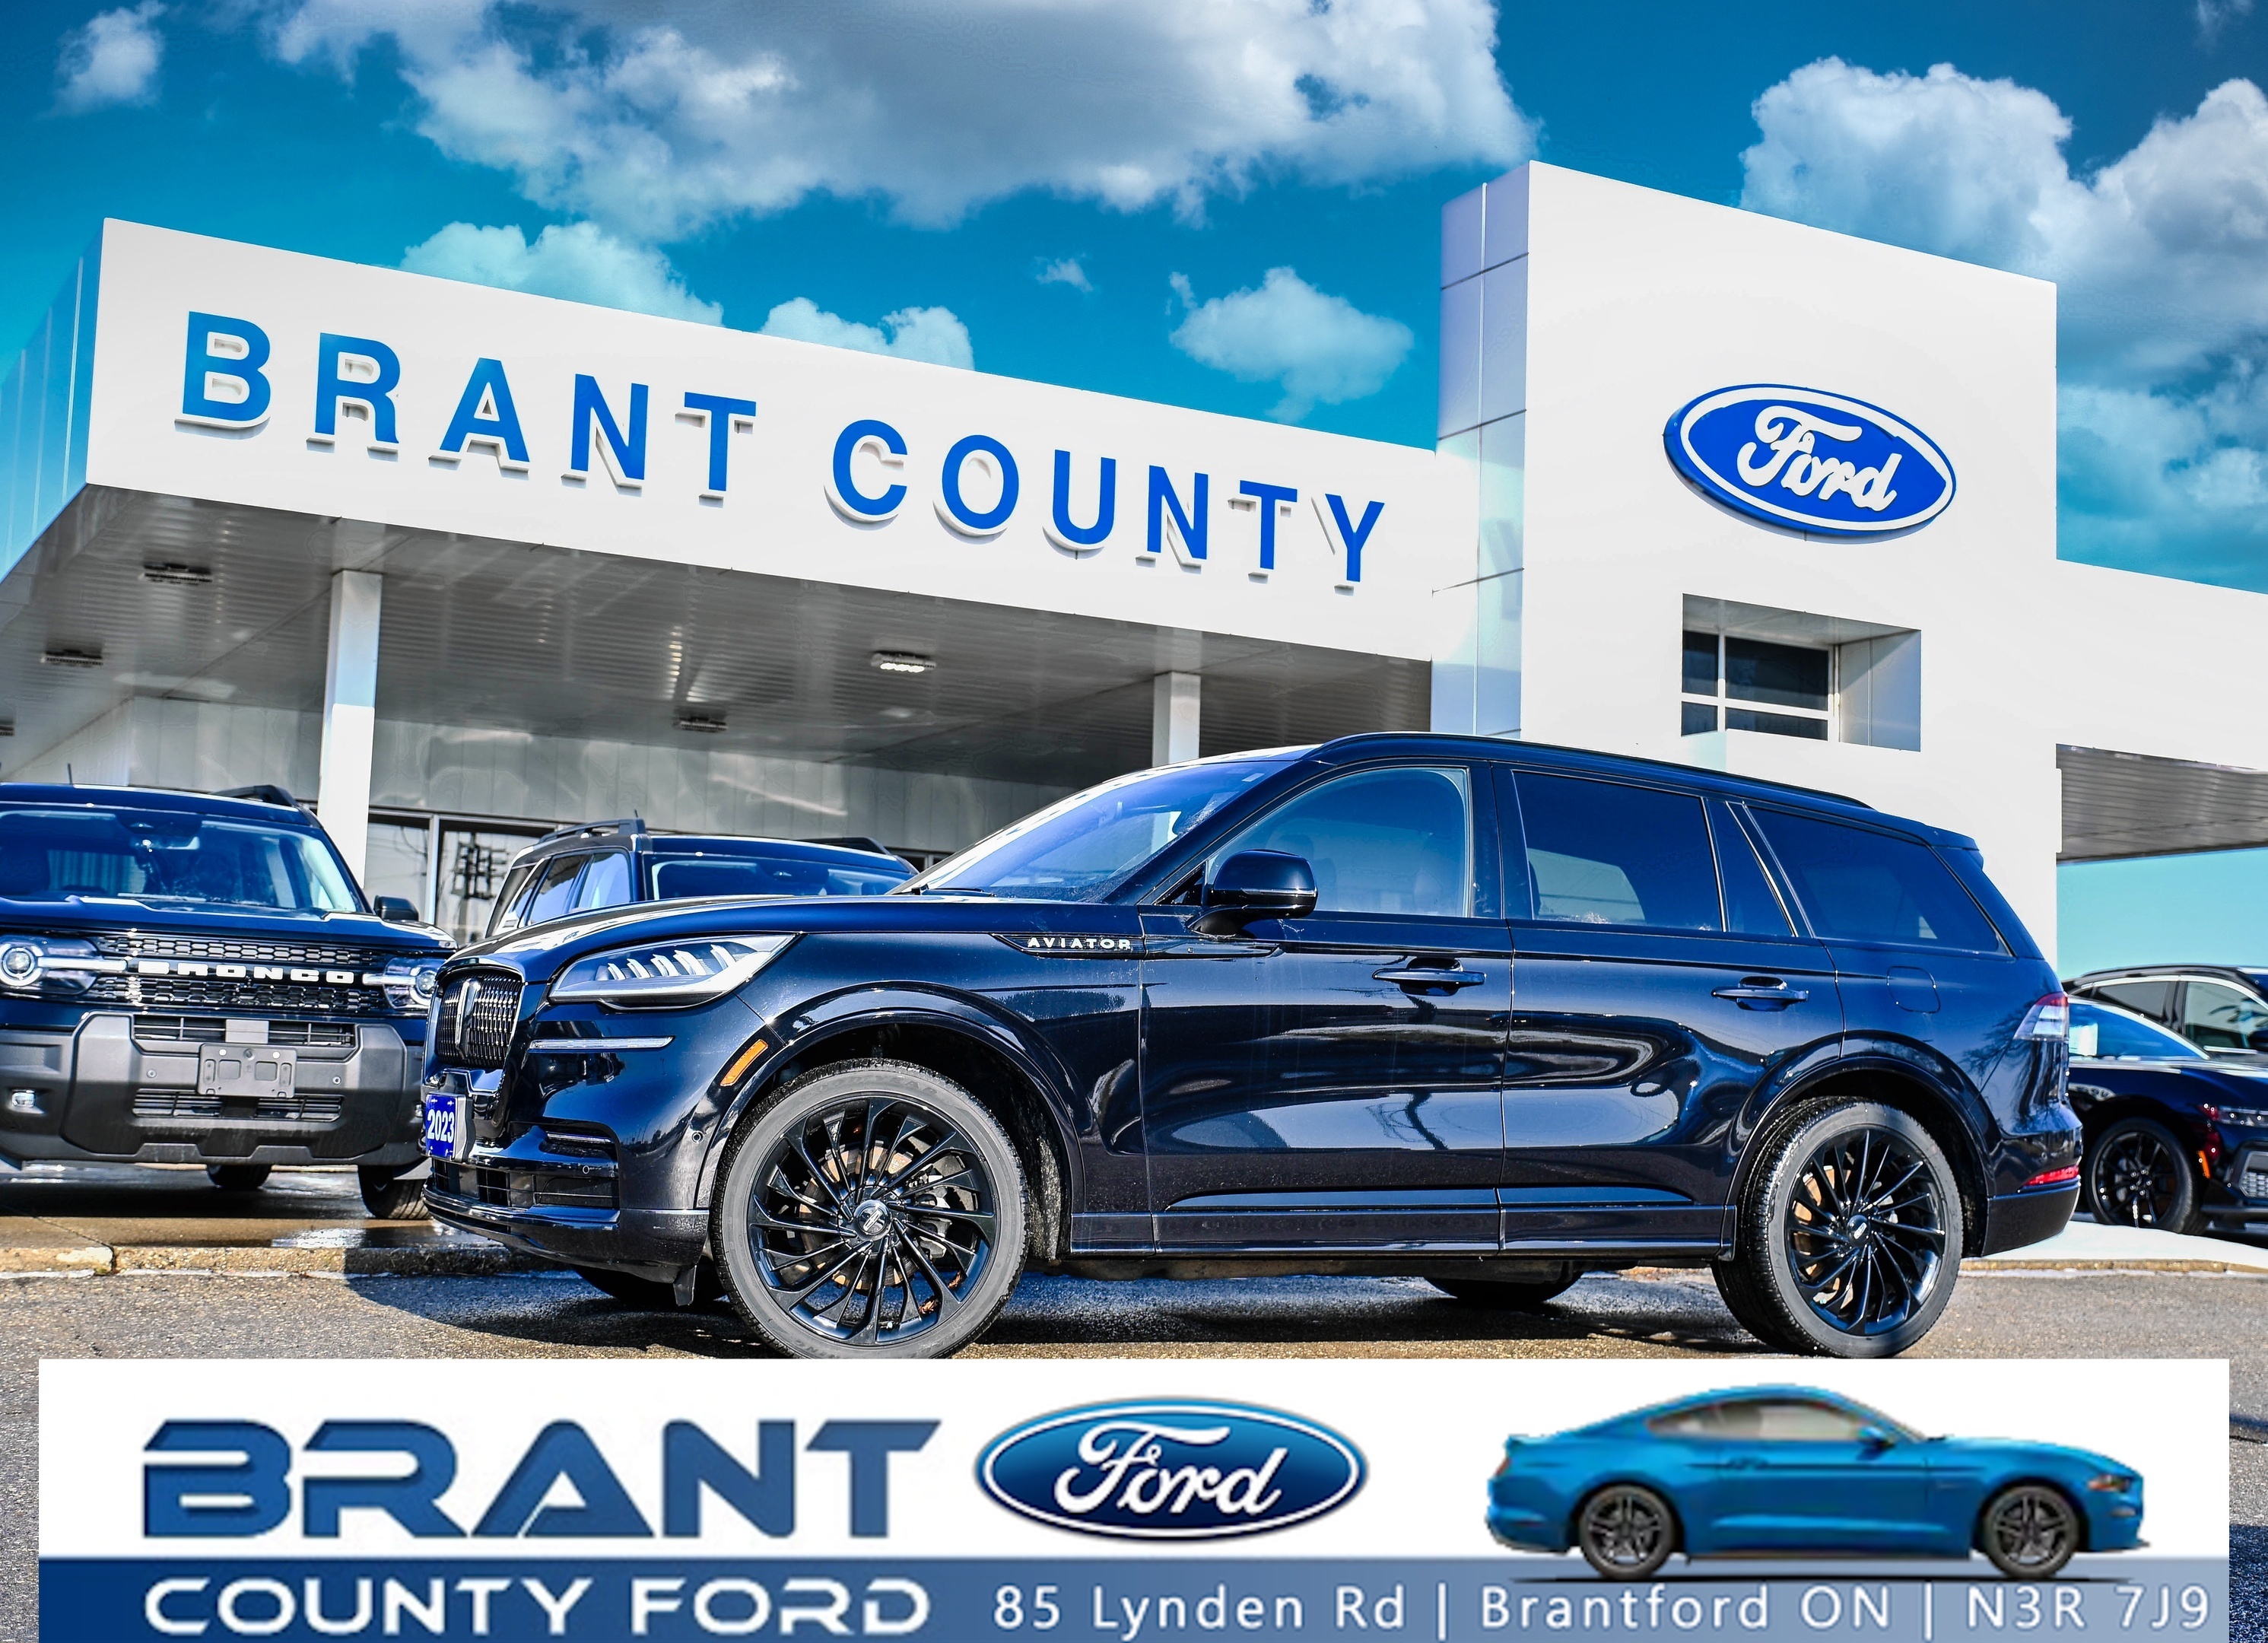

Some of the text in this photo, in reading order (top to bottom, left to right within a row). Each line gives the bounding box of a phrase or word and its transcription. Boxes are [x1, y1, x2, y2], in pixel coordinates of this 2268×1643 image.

[178, 310, 1386, 590] BRANT COUNTY
[1736, 405, 1902, 512] Ford
[1028, 936, 1131, 950] AVIATOR
[138, 960, 354, 984] BRONCO
[427, 1108, 455, 1144] 2023
